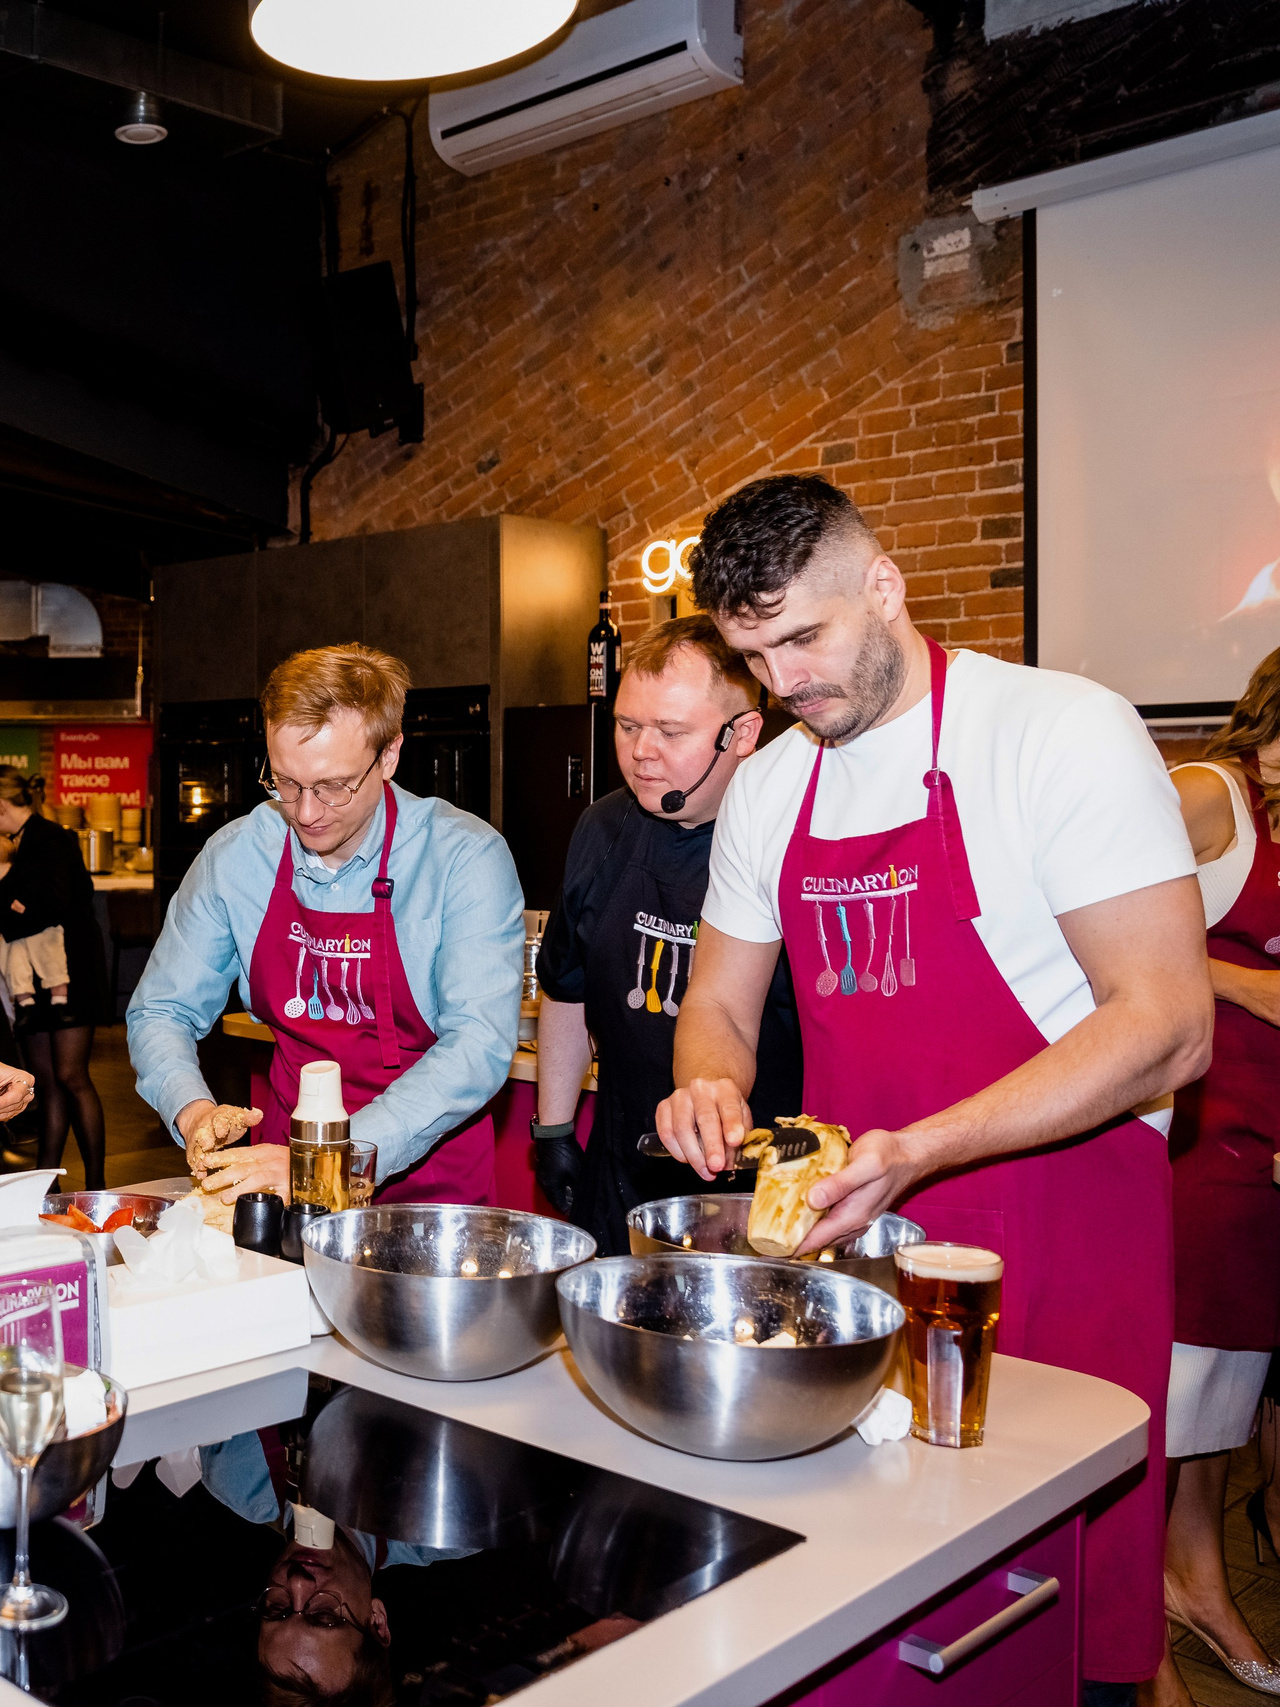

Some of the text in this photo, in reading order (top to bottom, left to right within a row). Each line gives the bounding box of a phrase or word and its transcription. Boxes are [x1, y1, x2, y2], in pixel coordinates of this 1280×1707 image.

[60, 753, 130, 770] Мы вам
[60, 774, 110, 788] такое
[635, 911, 694, 938] CULINARY
